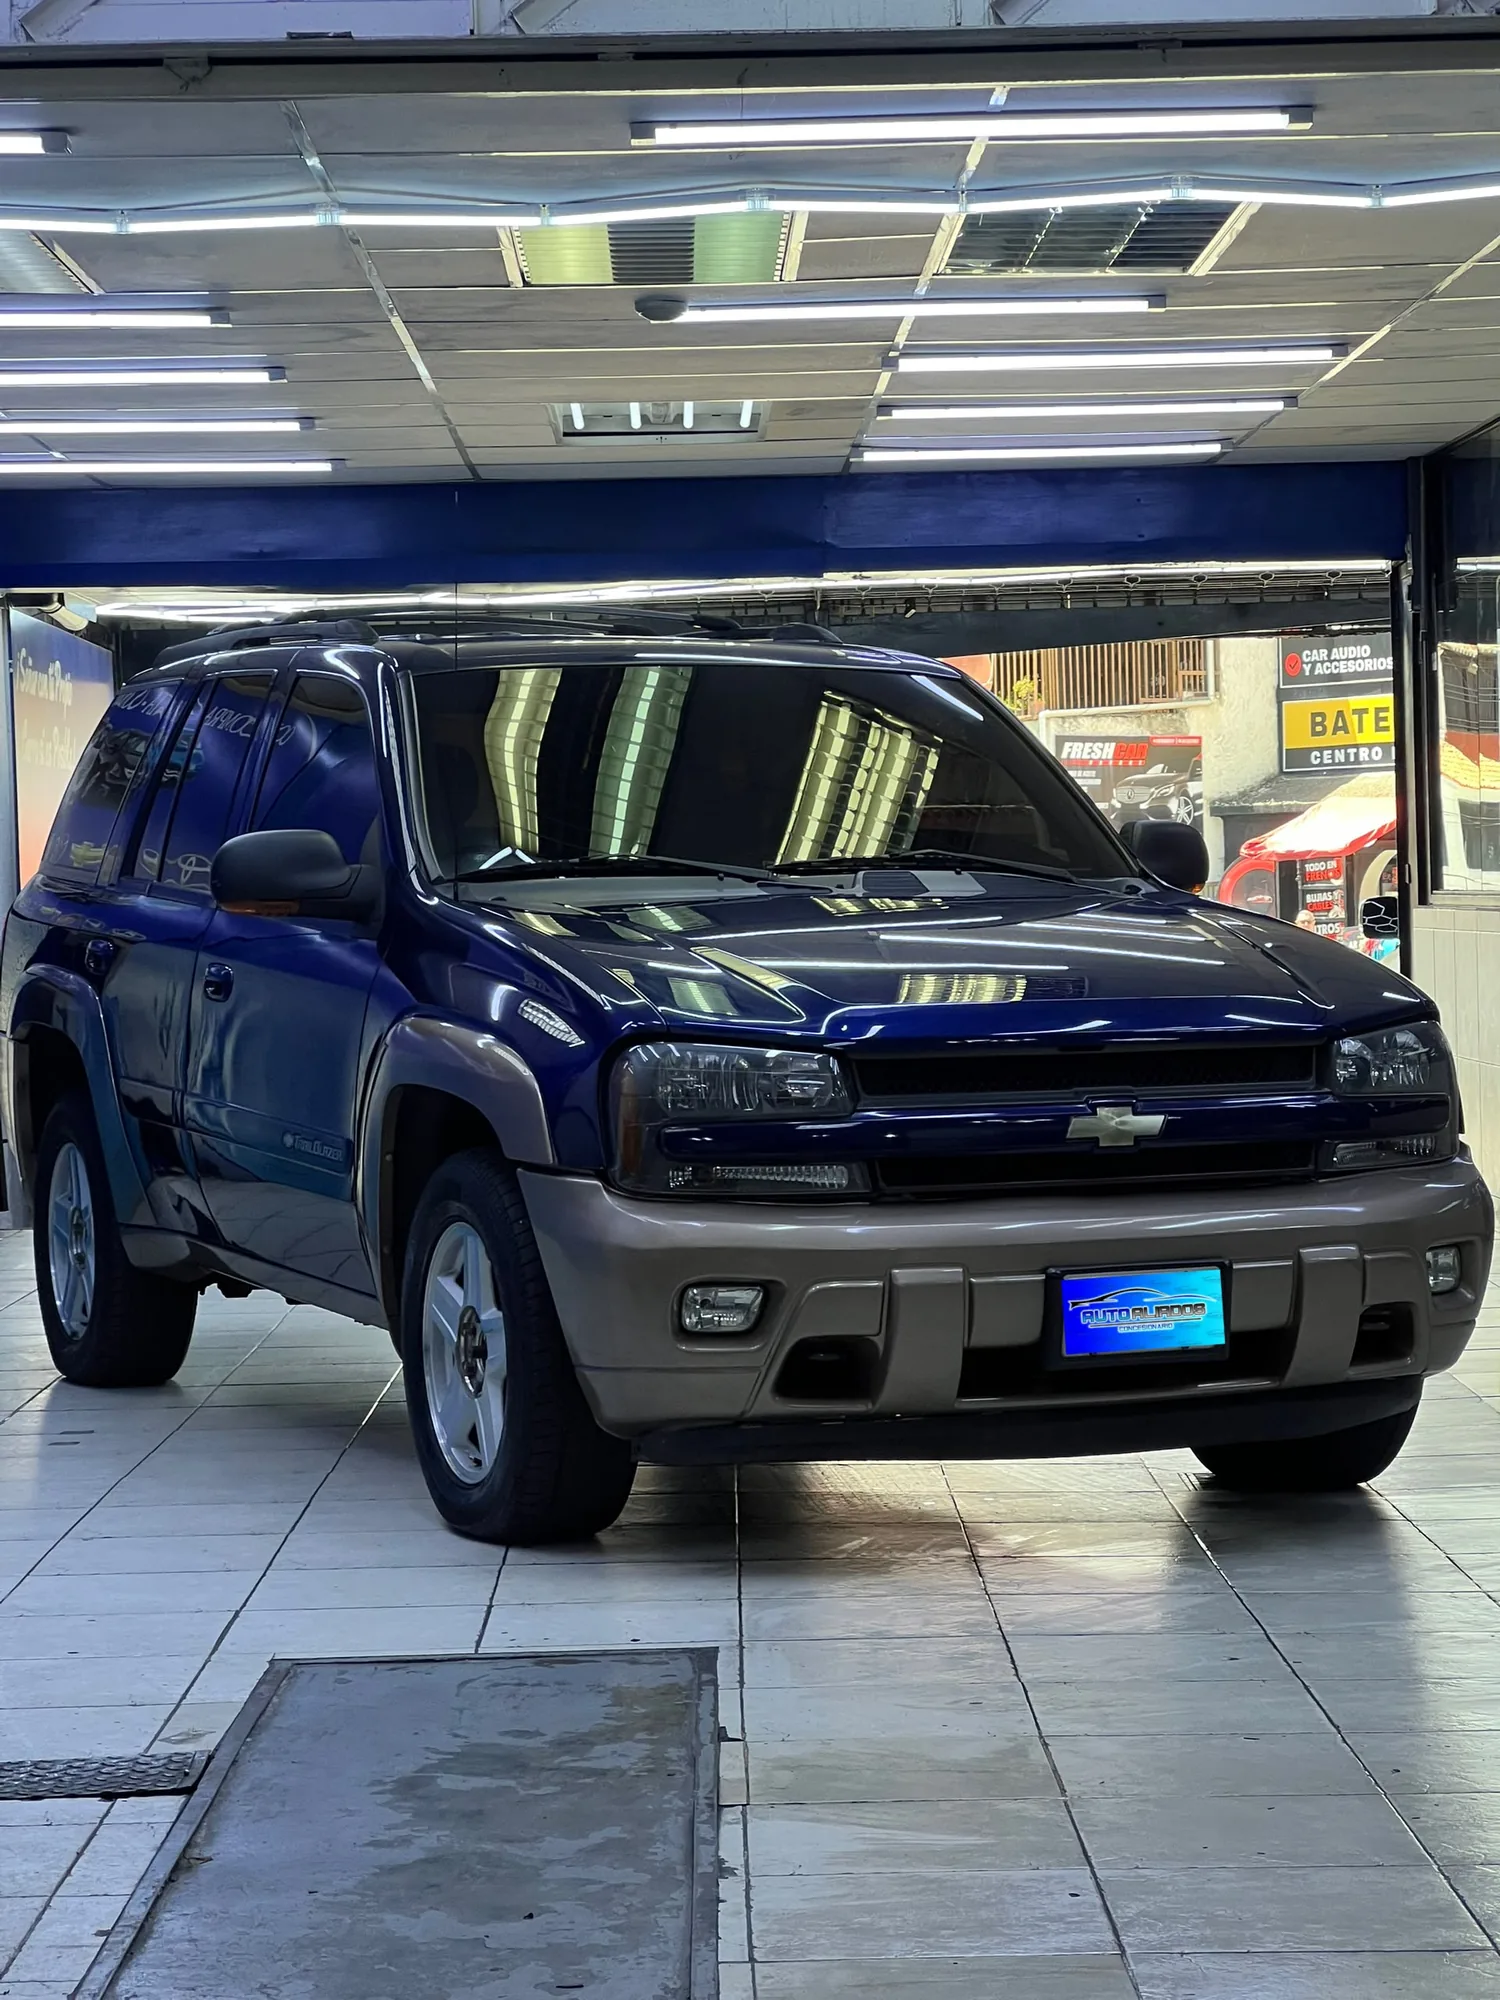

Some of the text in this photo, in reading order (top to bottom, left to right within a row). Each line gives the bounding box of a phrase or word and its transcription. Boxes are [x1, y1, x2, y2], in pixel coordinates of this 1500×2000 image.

[1302, 645, 1371, 662] CAR AUDIO
[1303, 657, 1393, 675] Y ACCESORIOS
[1311, 746, 1382, 764] CENTRO
[1305, 861, 1326, 872] TODO
[1307, 901, 1333, 911] CABLES
